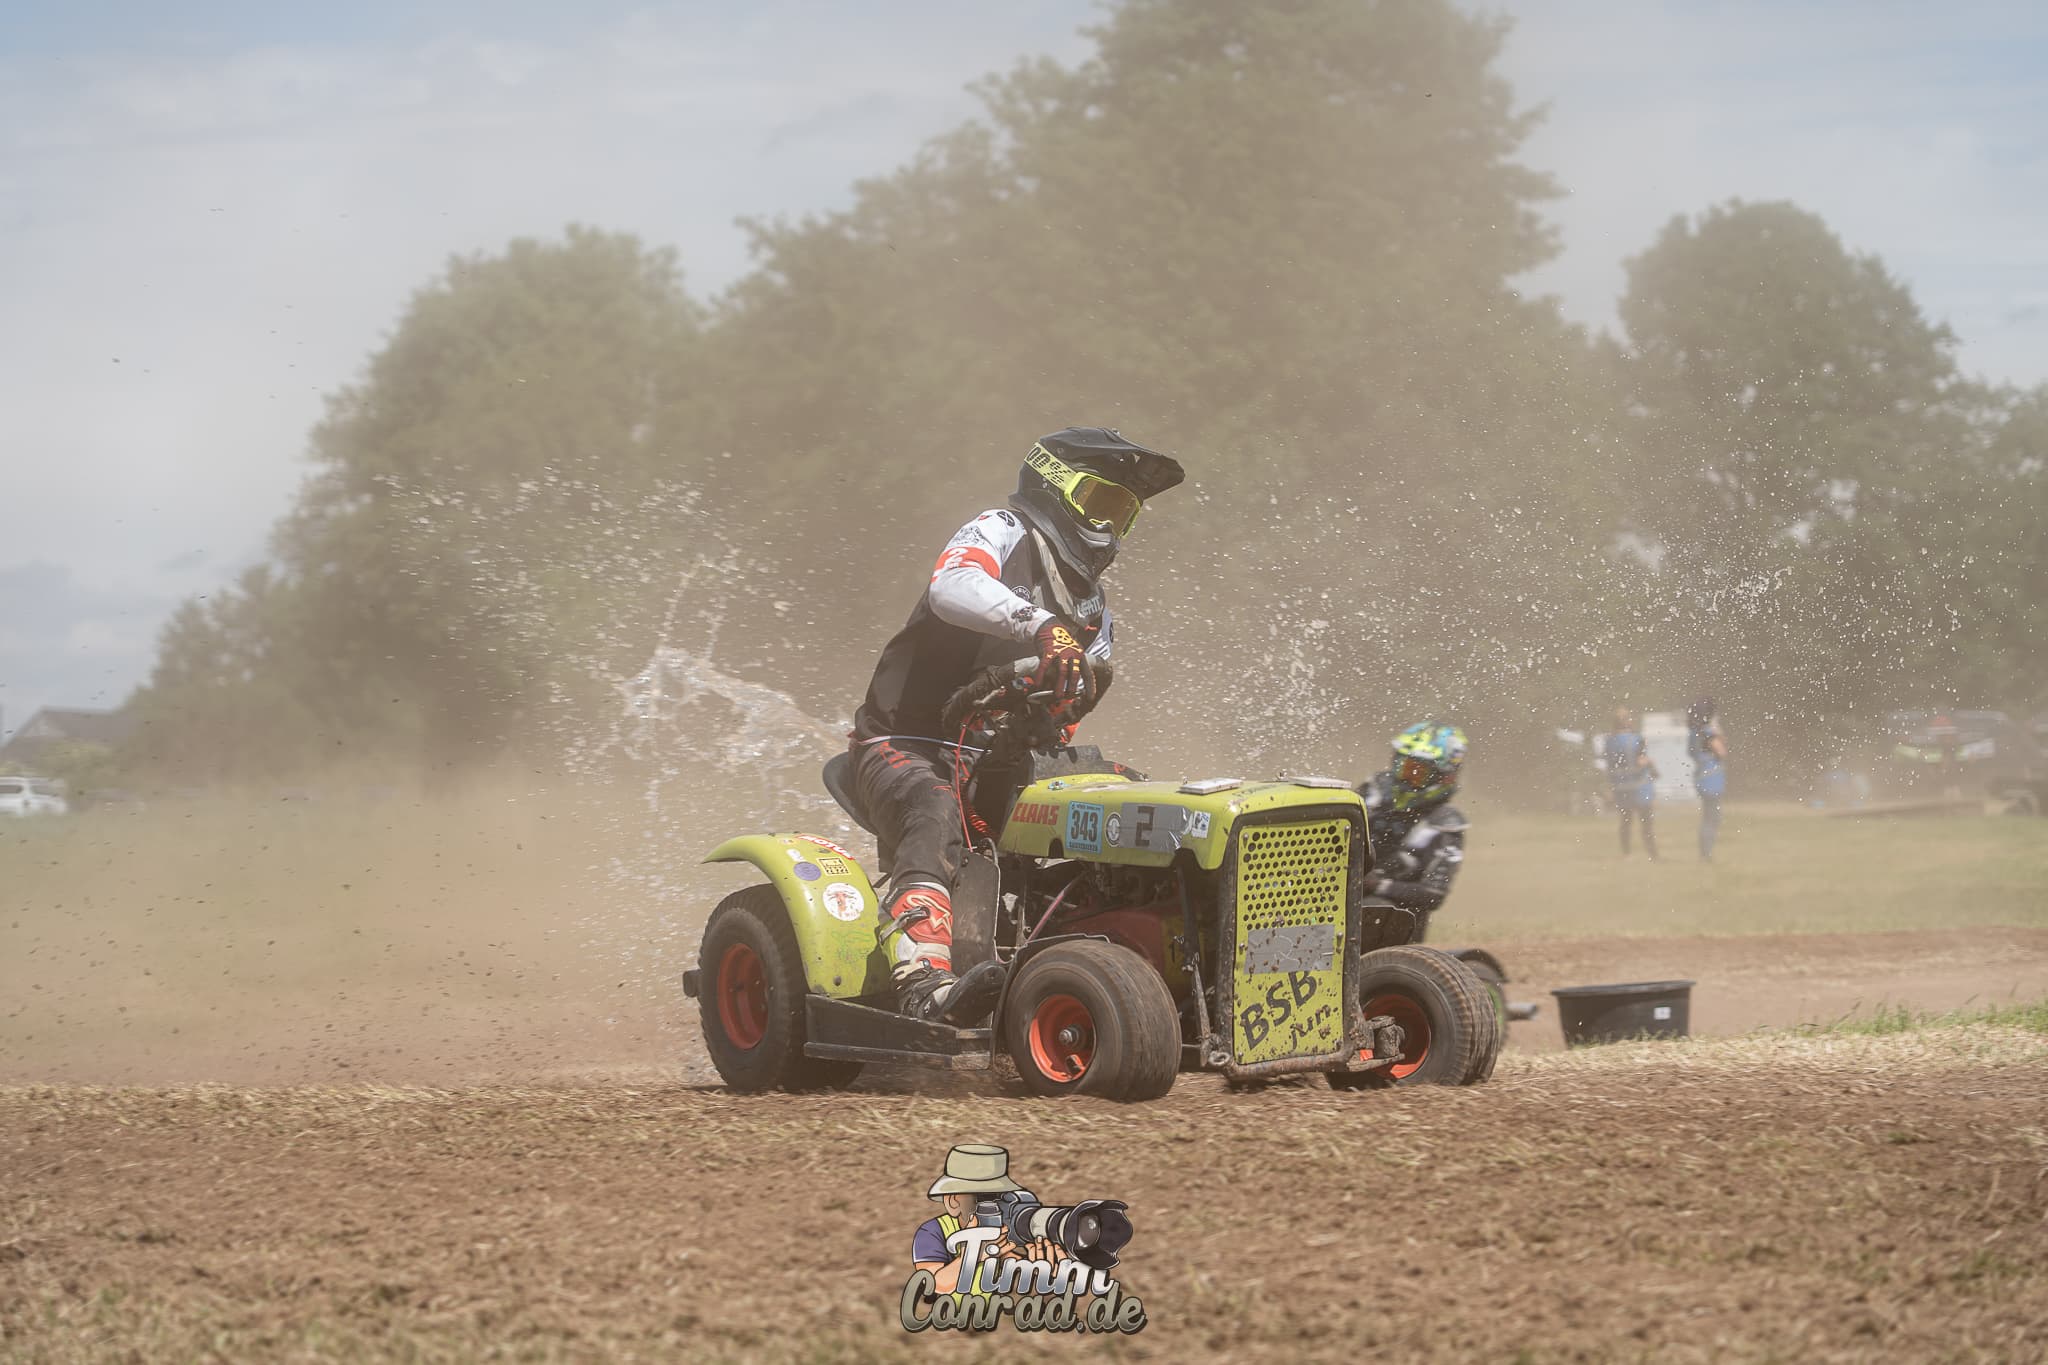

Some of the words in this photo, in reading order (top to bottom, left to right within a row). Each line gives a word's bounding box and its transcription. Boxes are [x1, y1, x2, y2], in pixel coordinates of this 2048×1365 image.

[1012, 802, 1060, 825] CLAAS
[1070, 810, 1099, 843] 343
[1135, 805, 1156, 847] 2
[1240, 970, 1318, 1051] BSB
